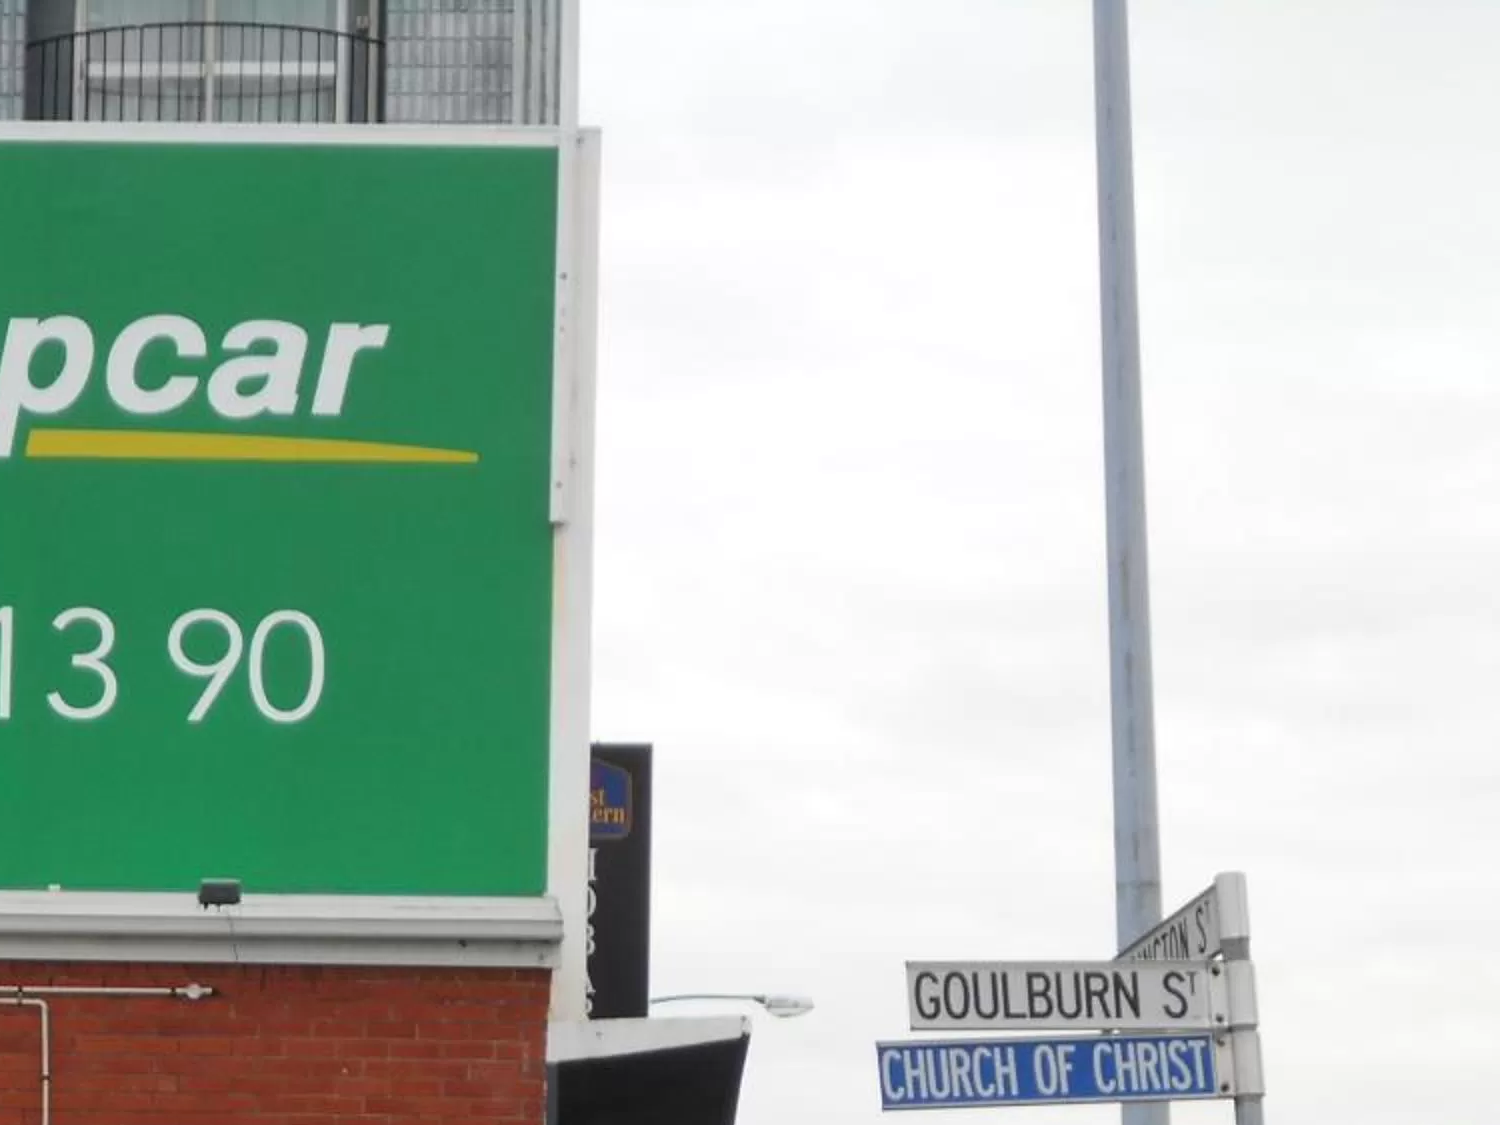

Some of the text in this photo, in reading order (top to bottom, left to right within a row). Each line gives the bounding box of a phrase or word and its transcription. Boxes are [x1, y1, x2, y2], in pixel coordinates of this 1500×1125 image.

[167, 608, 325, 724] 90
[913, 970, 1198, 1020] GOULBURN ST
[881, 1039, 1206, 1100] CHURCH OF CHRIST
